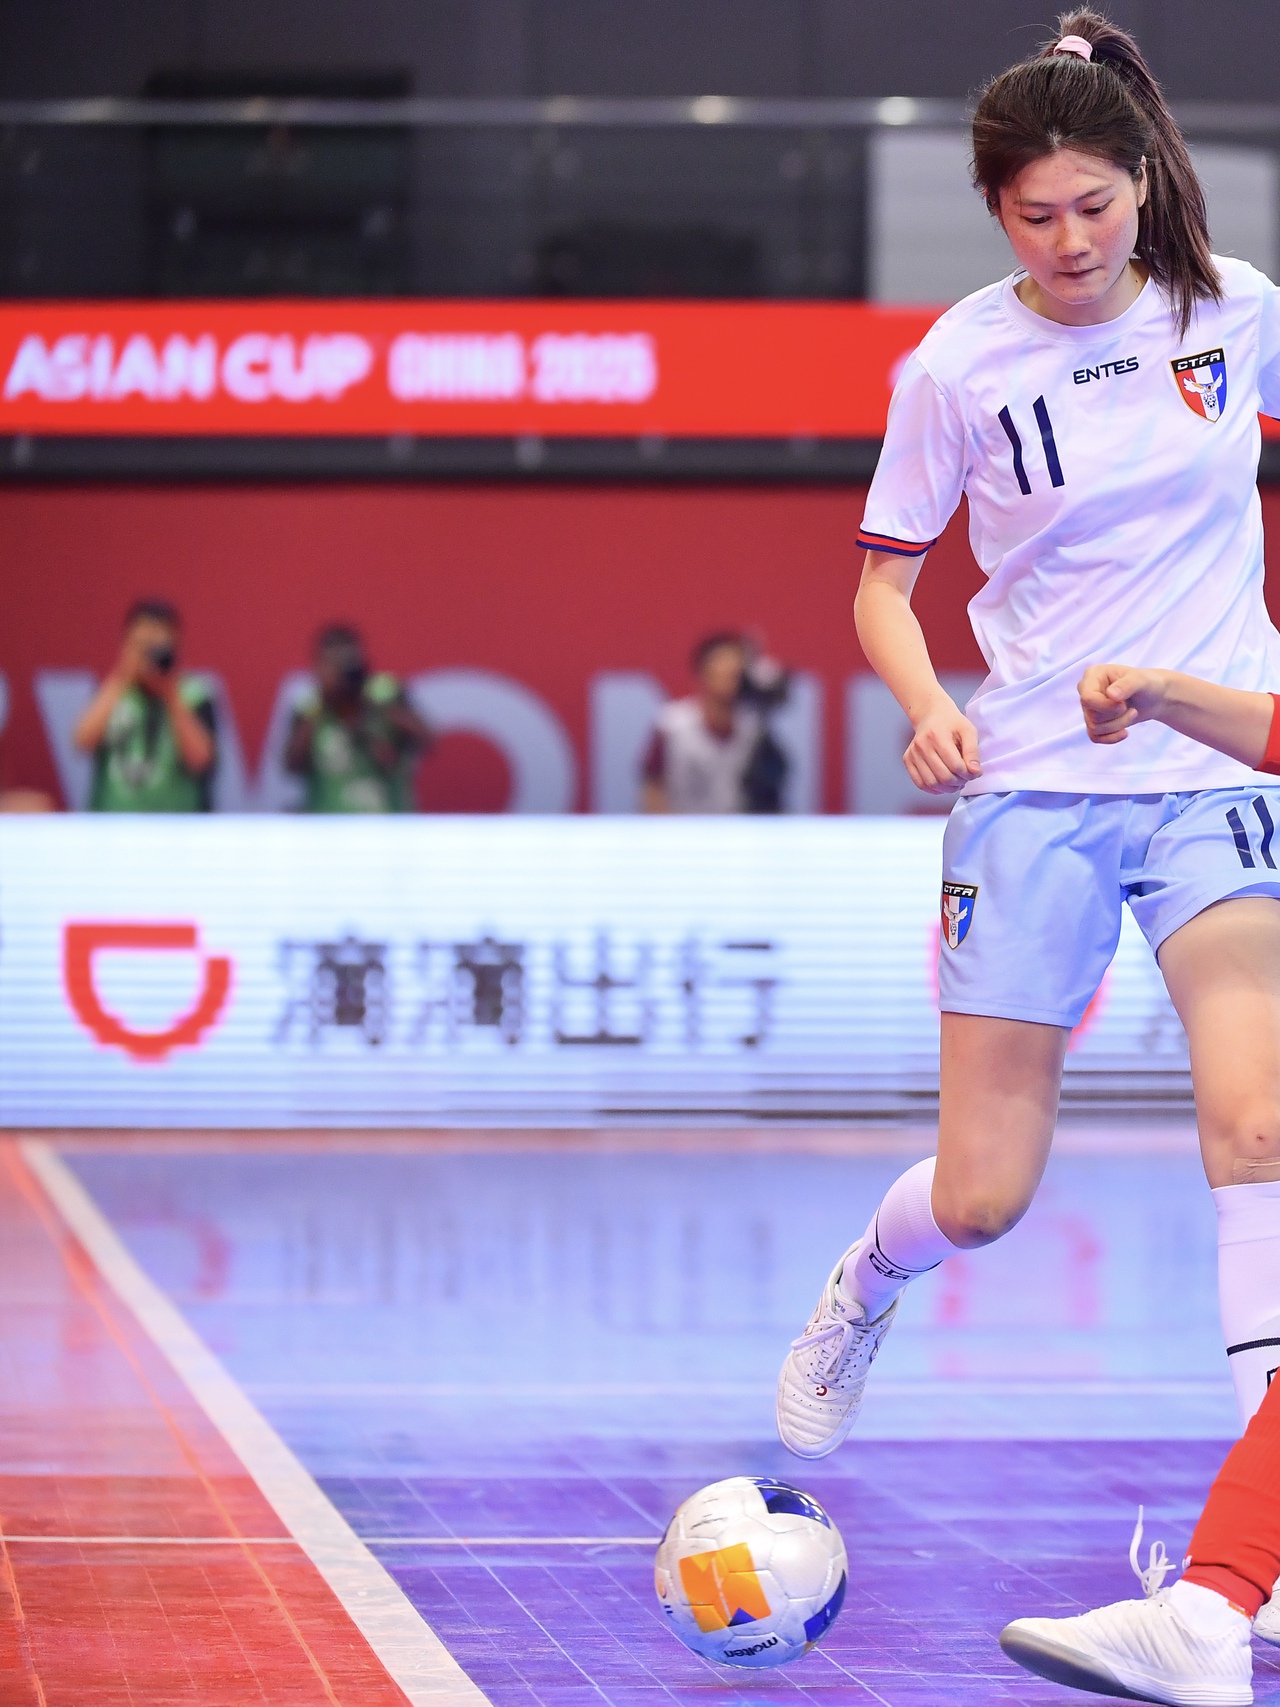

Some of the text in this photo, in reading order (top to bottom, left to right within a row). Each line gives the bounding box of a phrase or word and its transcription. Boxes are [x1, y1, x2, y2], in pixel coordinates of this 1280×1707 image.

[6, 334, 215, 401] ASIAN
[221, 334, 373, 401] CUP
[1073, 356, 1140, 385] ENTES
[1177, 352, 1221, 371] CTFA
[998, 395, 1065, 496] 11
[1225, 794, 1278, 870] 11
[943, 884, 975, 897] CTFA
[723, 1636, 779, 1658] molten
